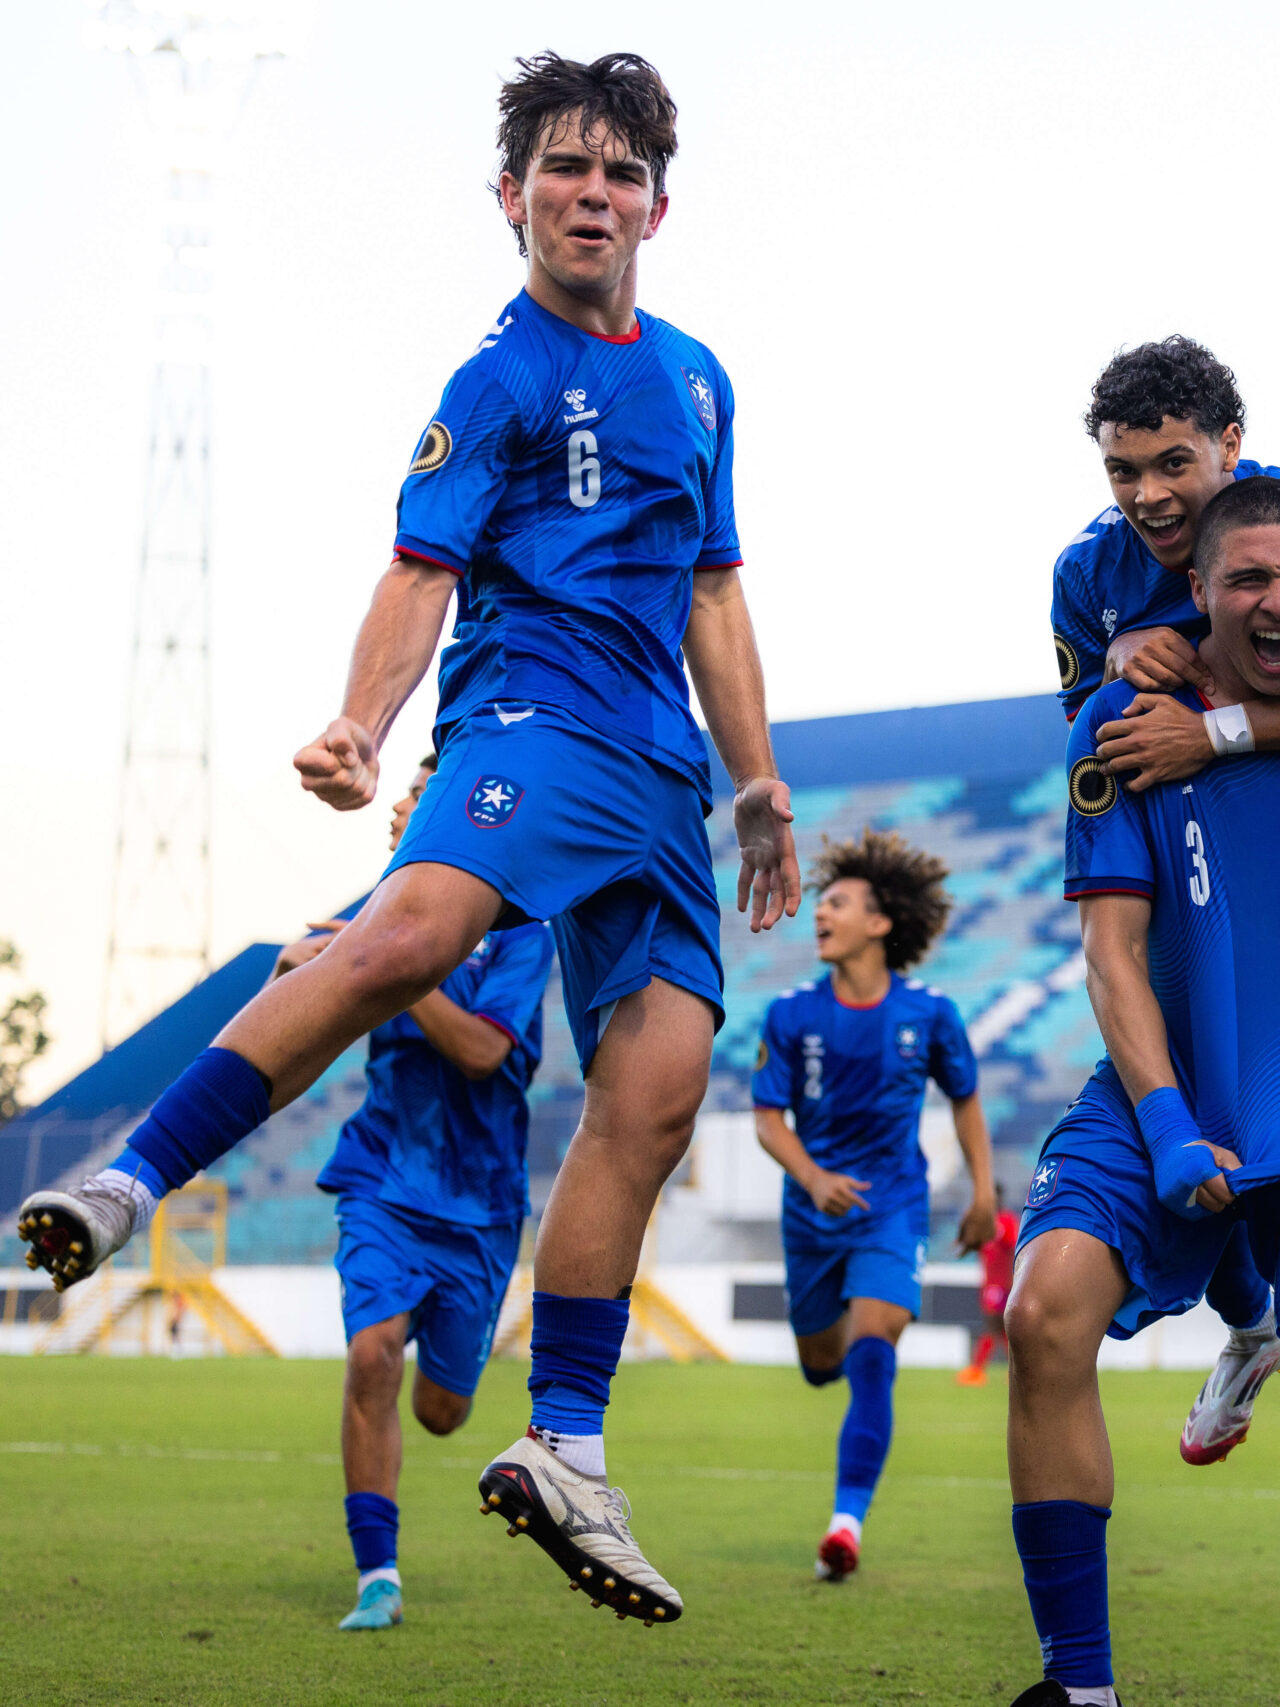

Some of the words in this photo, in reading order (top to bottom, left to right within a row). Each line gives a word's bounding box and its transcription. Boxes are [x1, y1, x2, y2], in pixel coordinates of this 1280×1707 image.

[563, 408, 599, 425] hummel
[568, 429, 601, 508] 6
[1185, 820, 1211, 906] 3
